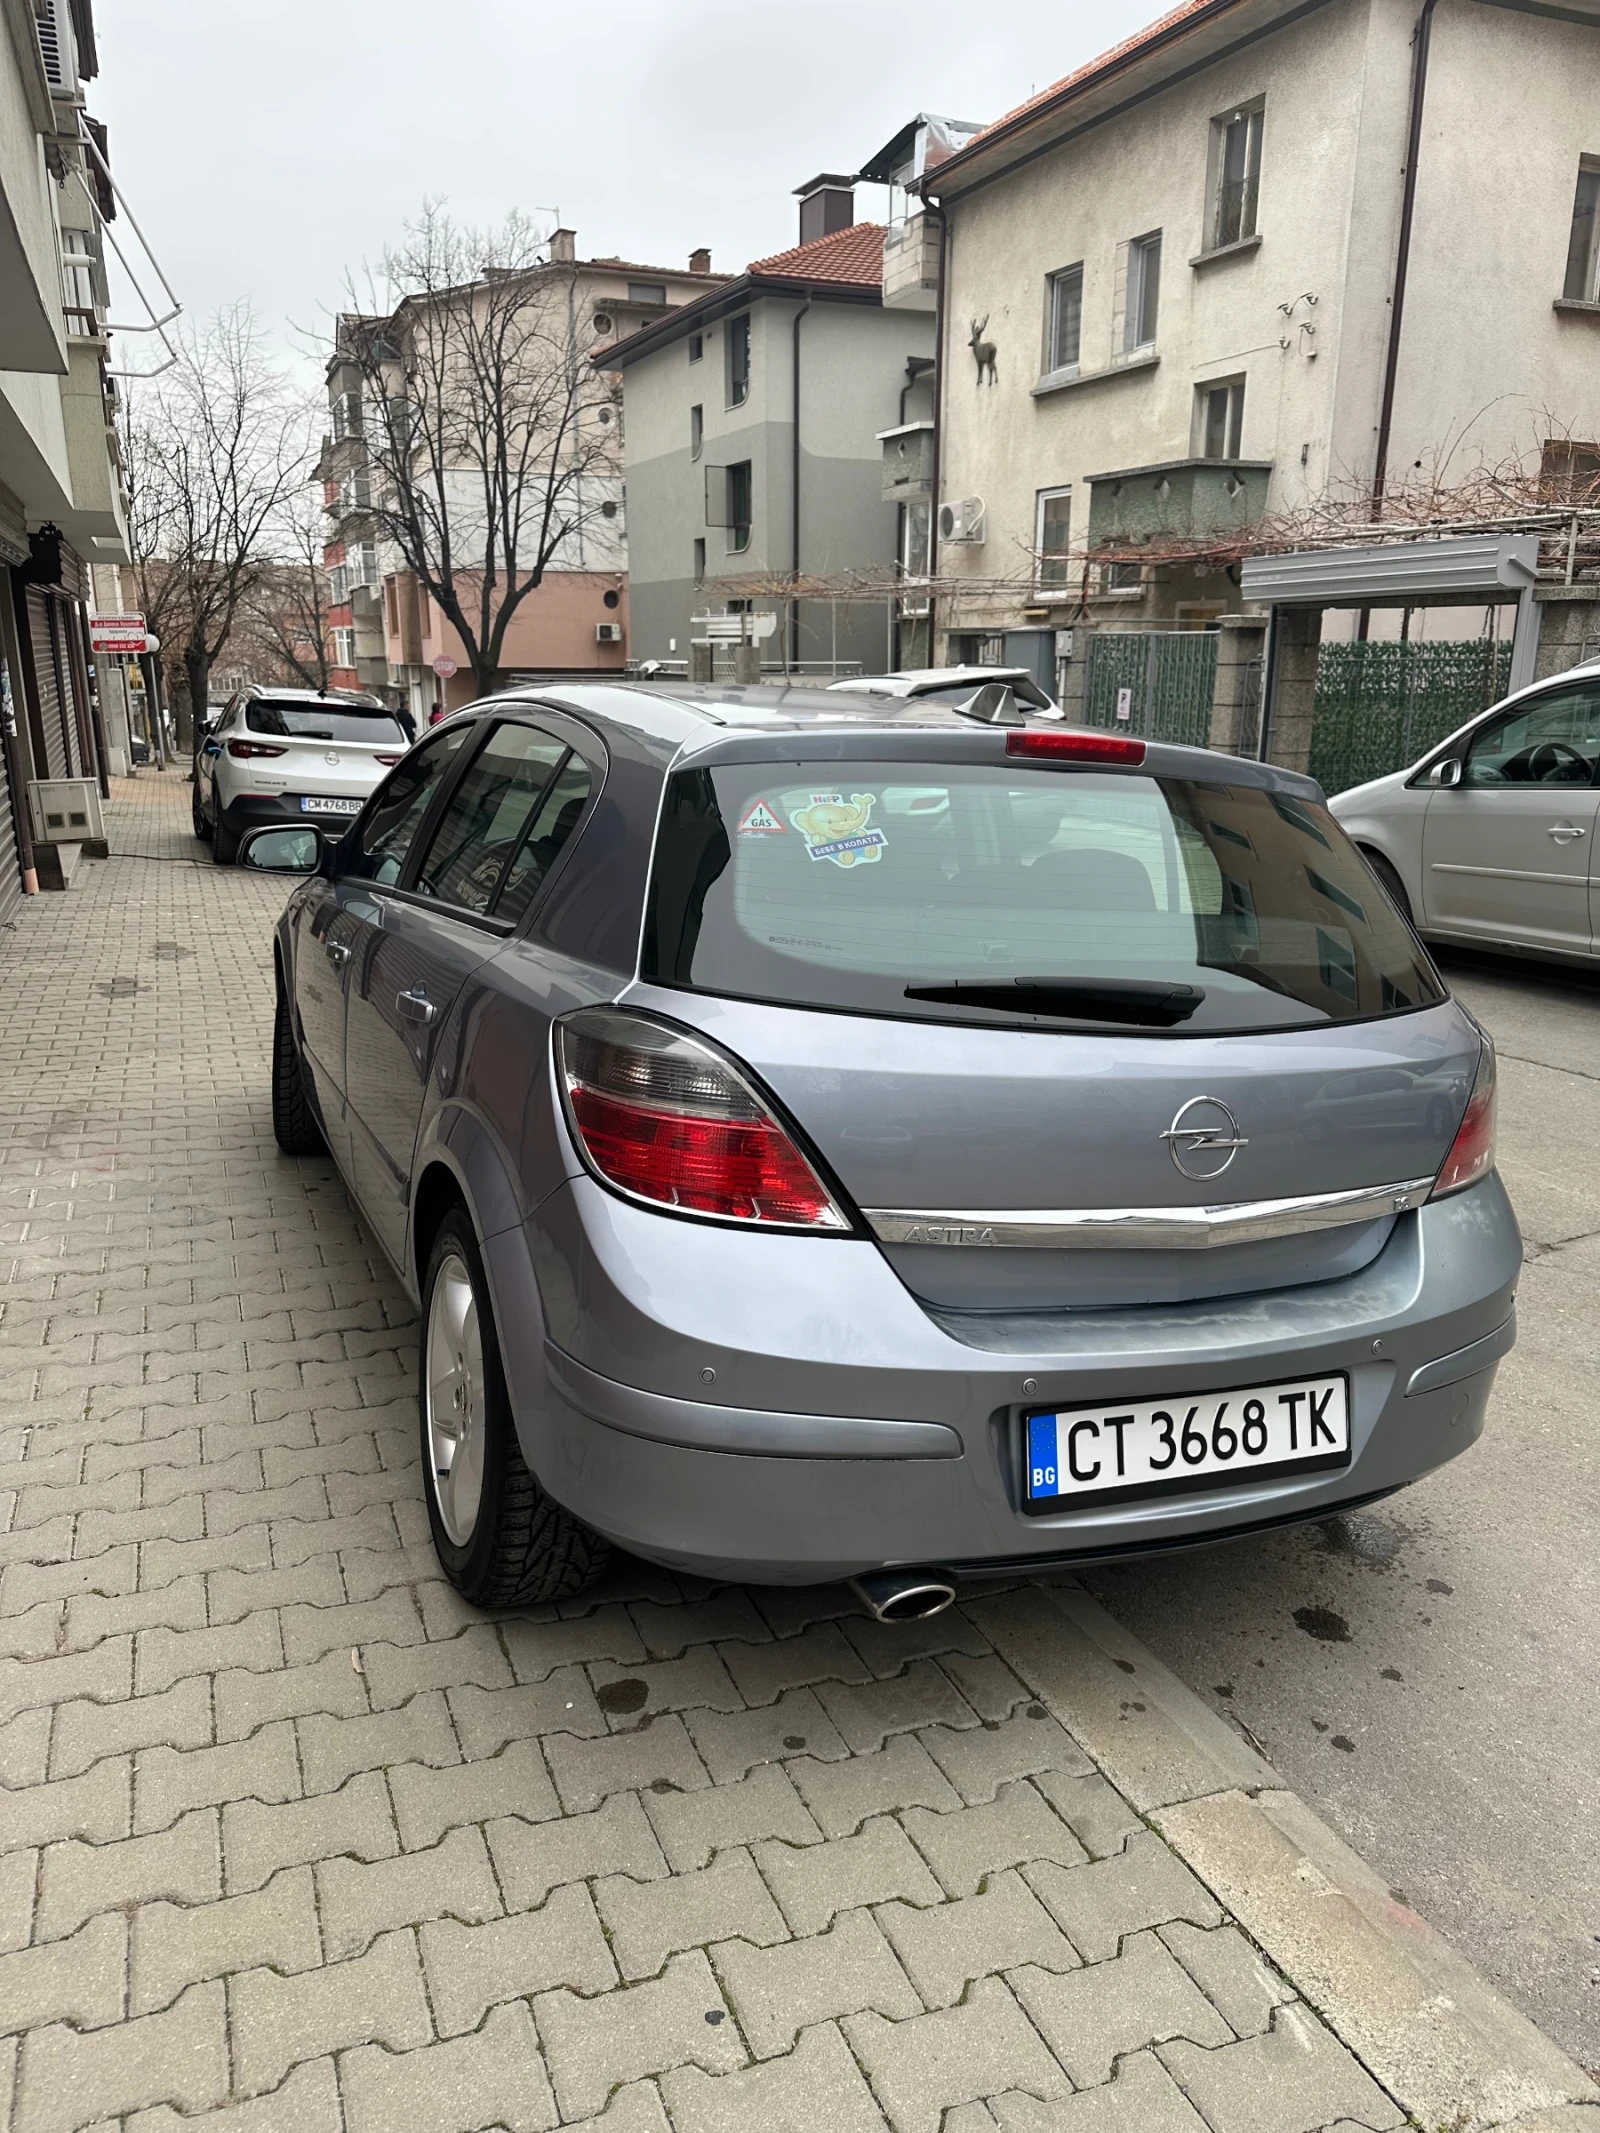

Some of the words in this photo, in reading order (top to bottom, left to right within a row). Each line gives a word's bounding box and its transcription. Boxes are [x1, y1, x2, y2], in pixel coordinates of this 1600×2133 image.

[436, 661, 454, 671] STOP
[308, 799, 322, 809] CM
[323, 800, 348, 811] 4768
[751, 819, 772, 827] GAS
[815, 845, 836, 856] БЕБЕ
[844, 836, 879, 849] КОЛАТА
[904, 1226, 998, 1243] ASTRA
[1068, 1414, 1135, 1481] CT
[1149, 1399, 1268, 1470] 3668
[1278, 1388, 1337, 1450] TK
[1033, 1466, 1055, 1487] BG
